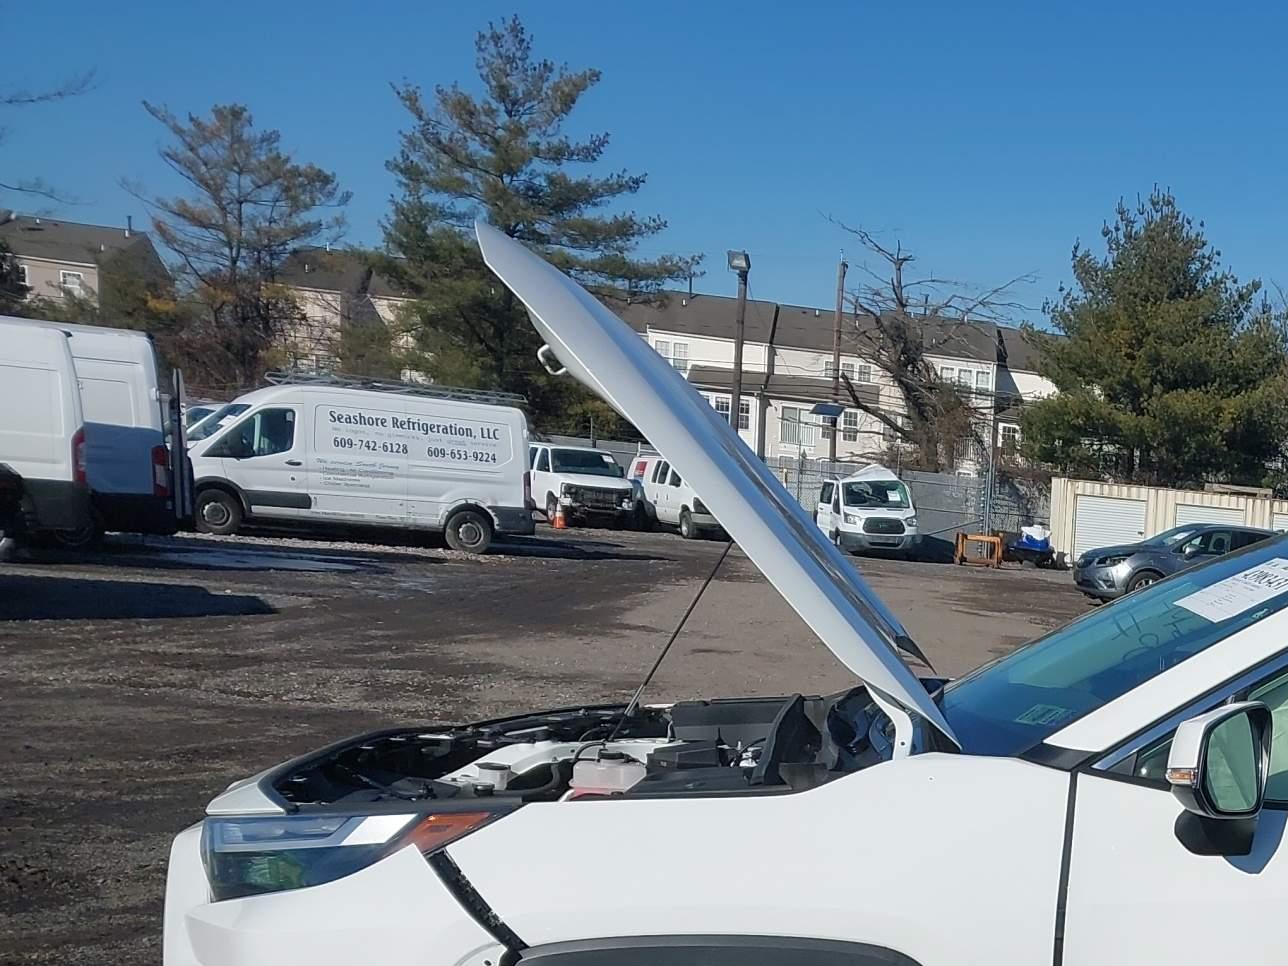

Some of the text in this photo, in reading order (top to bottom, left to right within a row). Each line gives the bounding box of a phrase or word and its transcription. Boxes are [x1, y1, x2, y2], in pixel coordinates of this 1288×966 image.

[329, 410, 388, 428] Seashore
[391, 416, 477, 440] Refrigeration,
[480, 426, 500, 441] LLC
[333, 436, 409, 455] 609-742-6128
[427, 446, 497, 464] 609-653-9224
